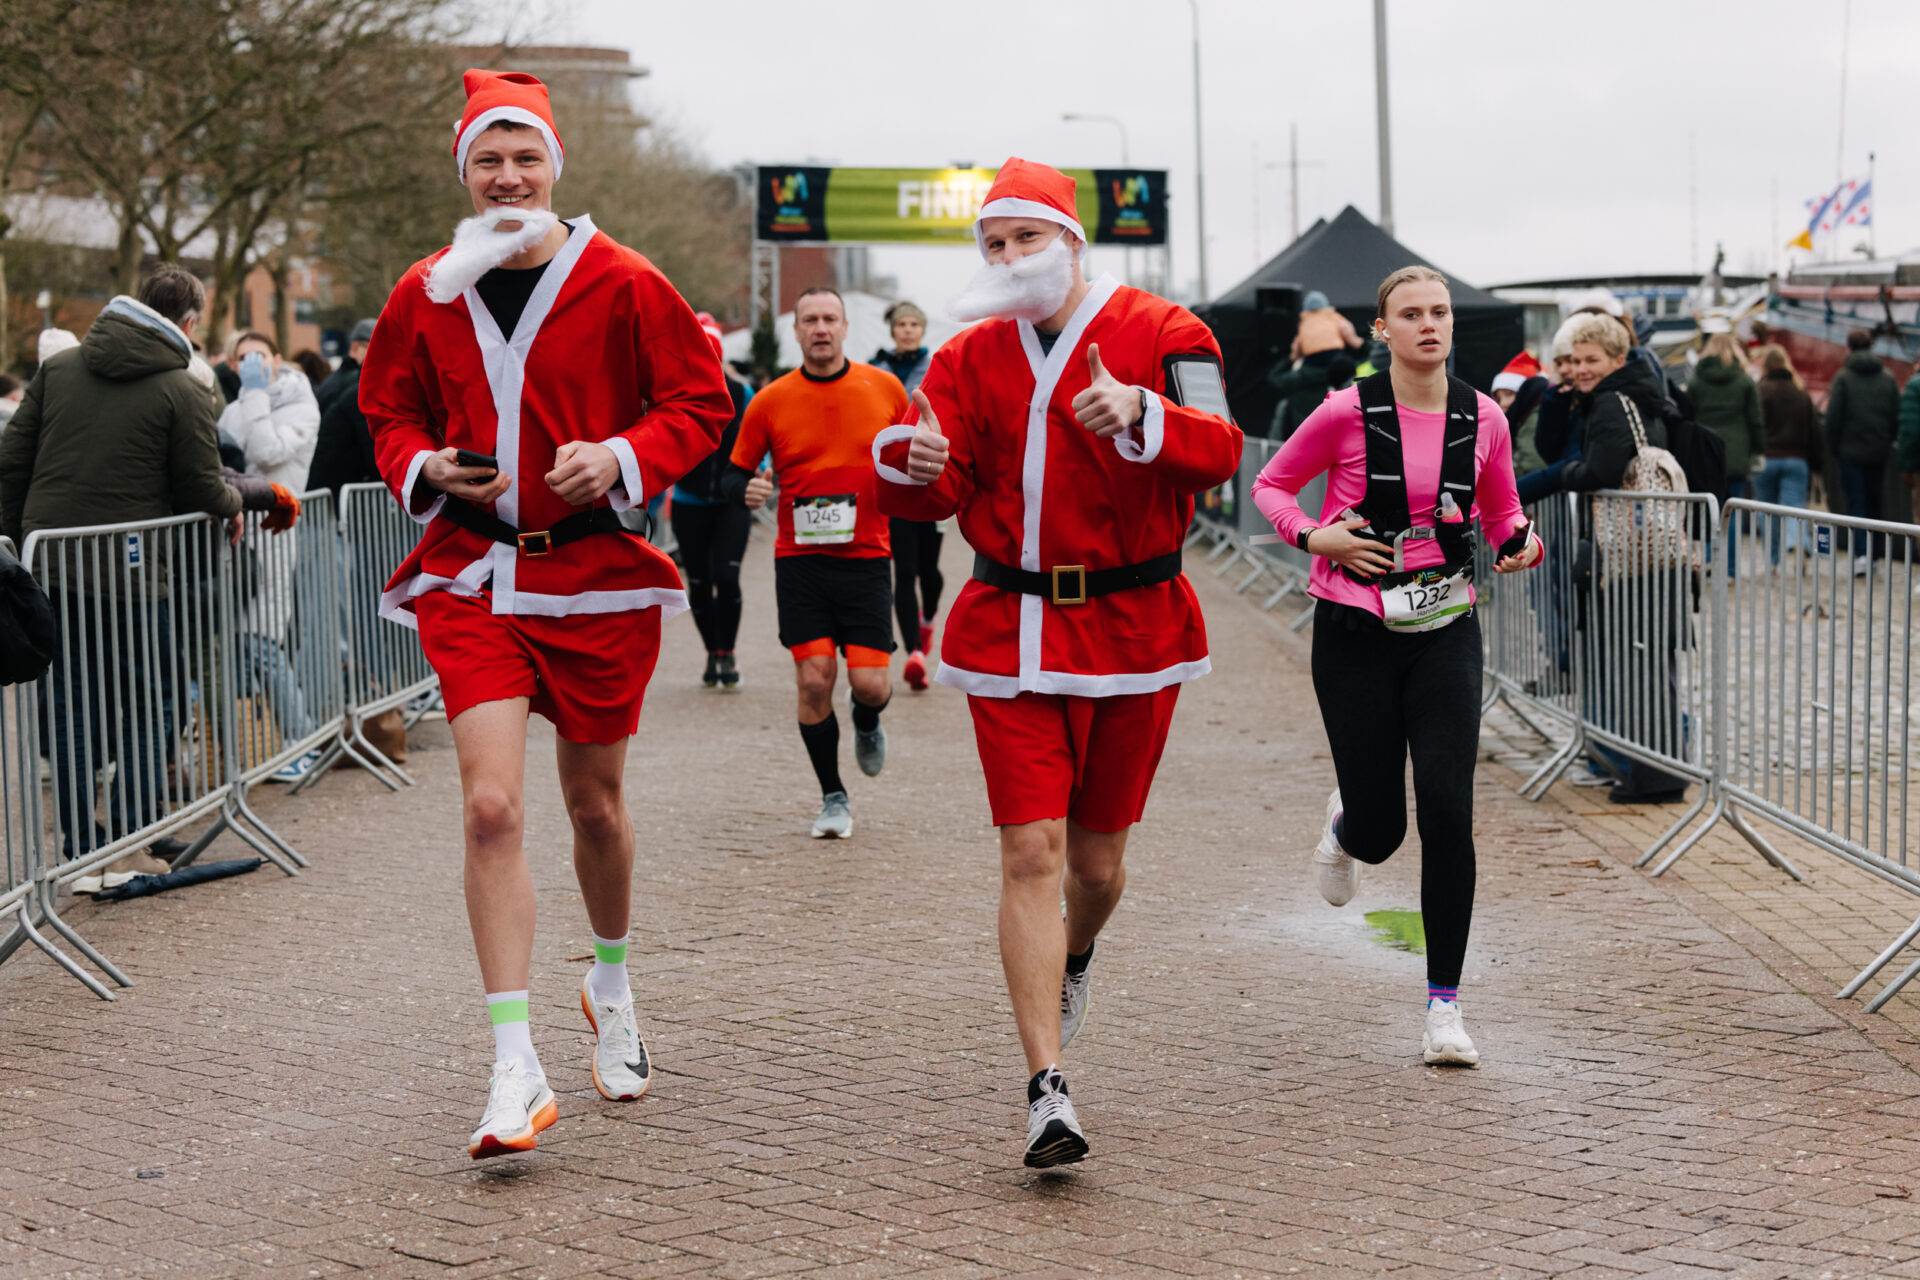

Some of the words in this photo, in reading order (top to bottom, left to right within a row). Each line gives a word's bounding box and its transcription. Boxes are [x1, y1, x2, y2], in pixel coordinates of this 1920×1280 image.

[898, 181, 994, 218] FINIS
[805, 508, 841, 524] 1245
[1404, 583, 1451, 611] 1232
